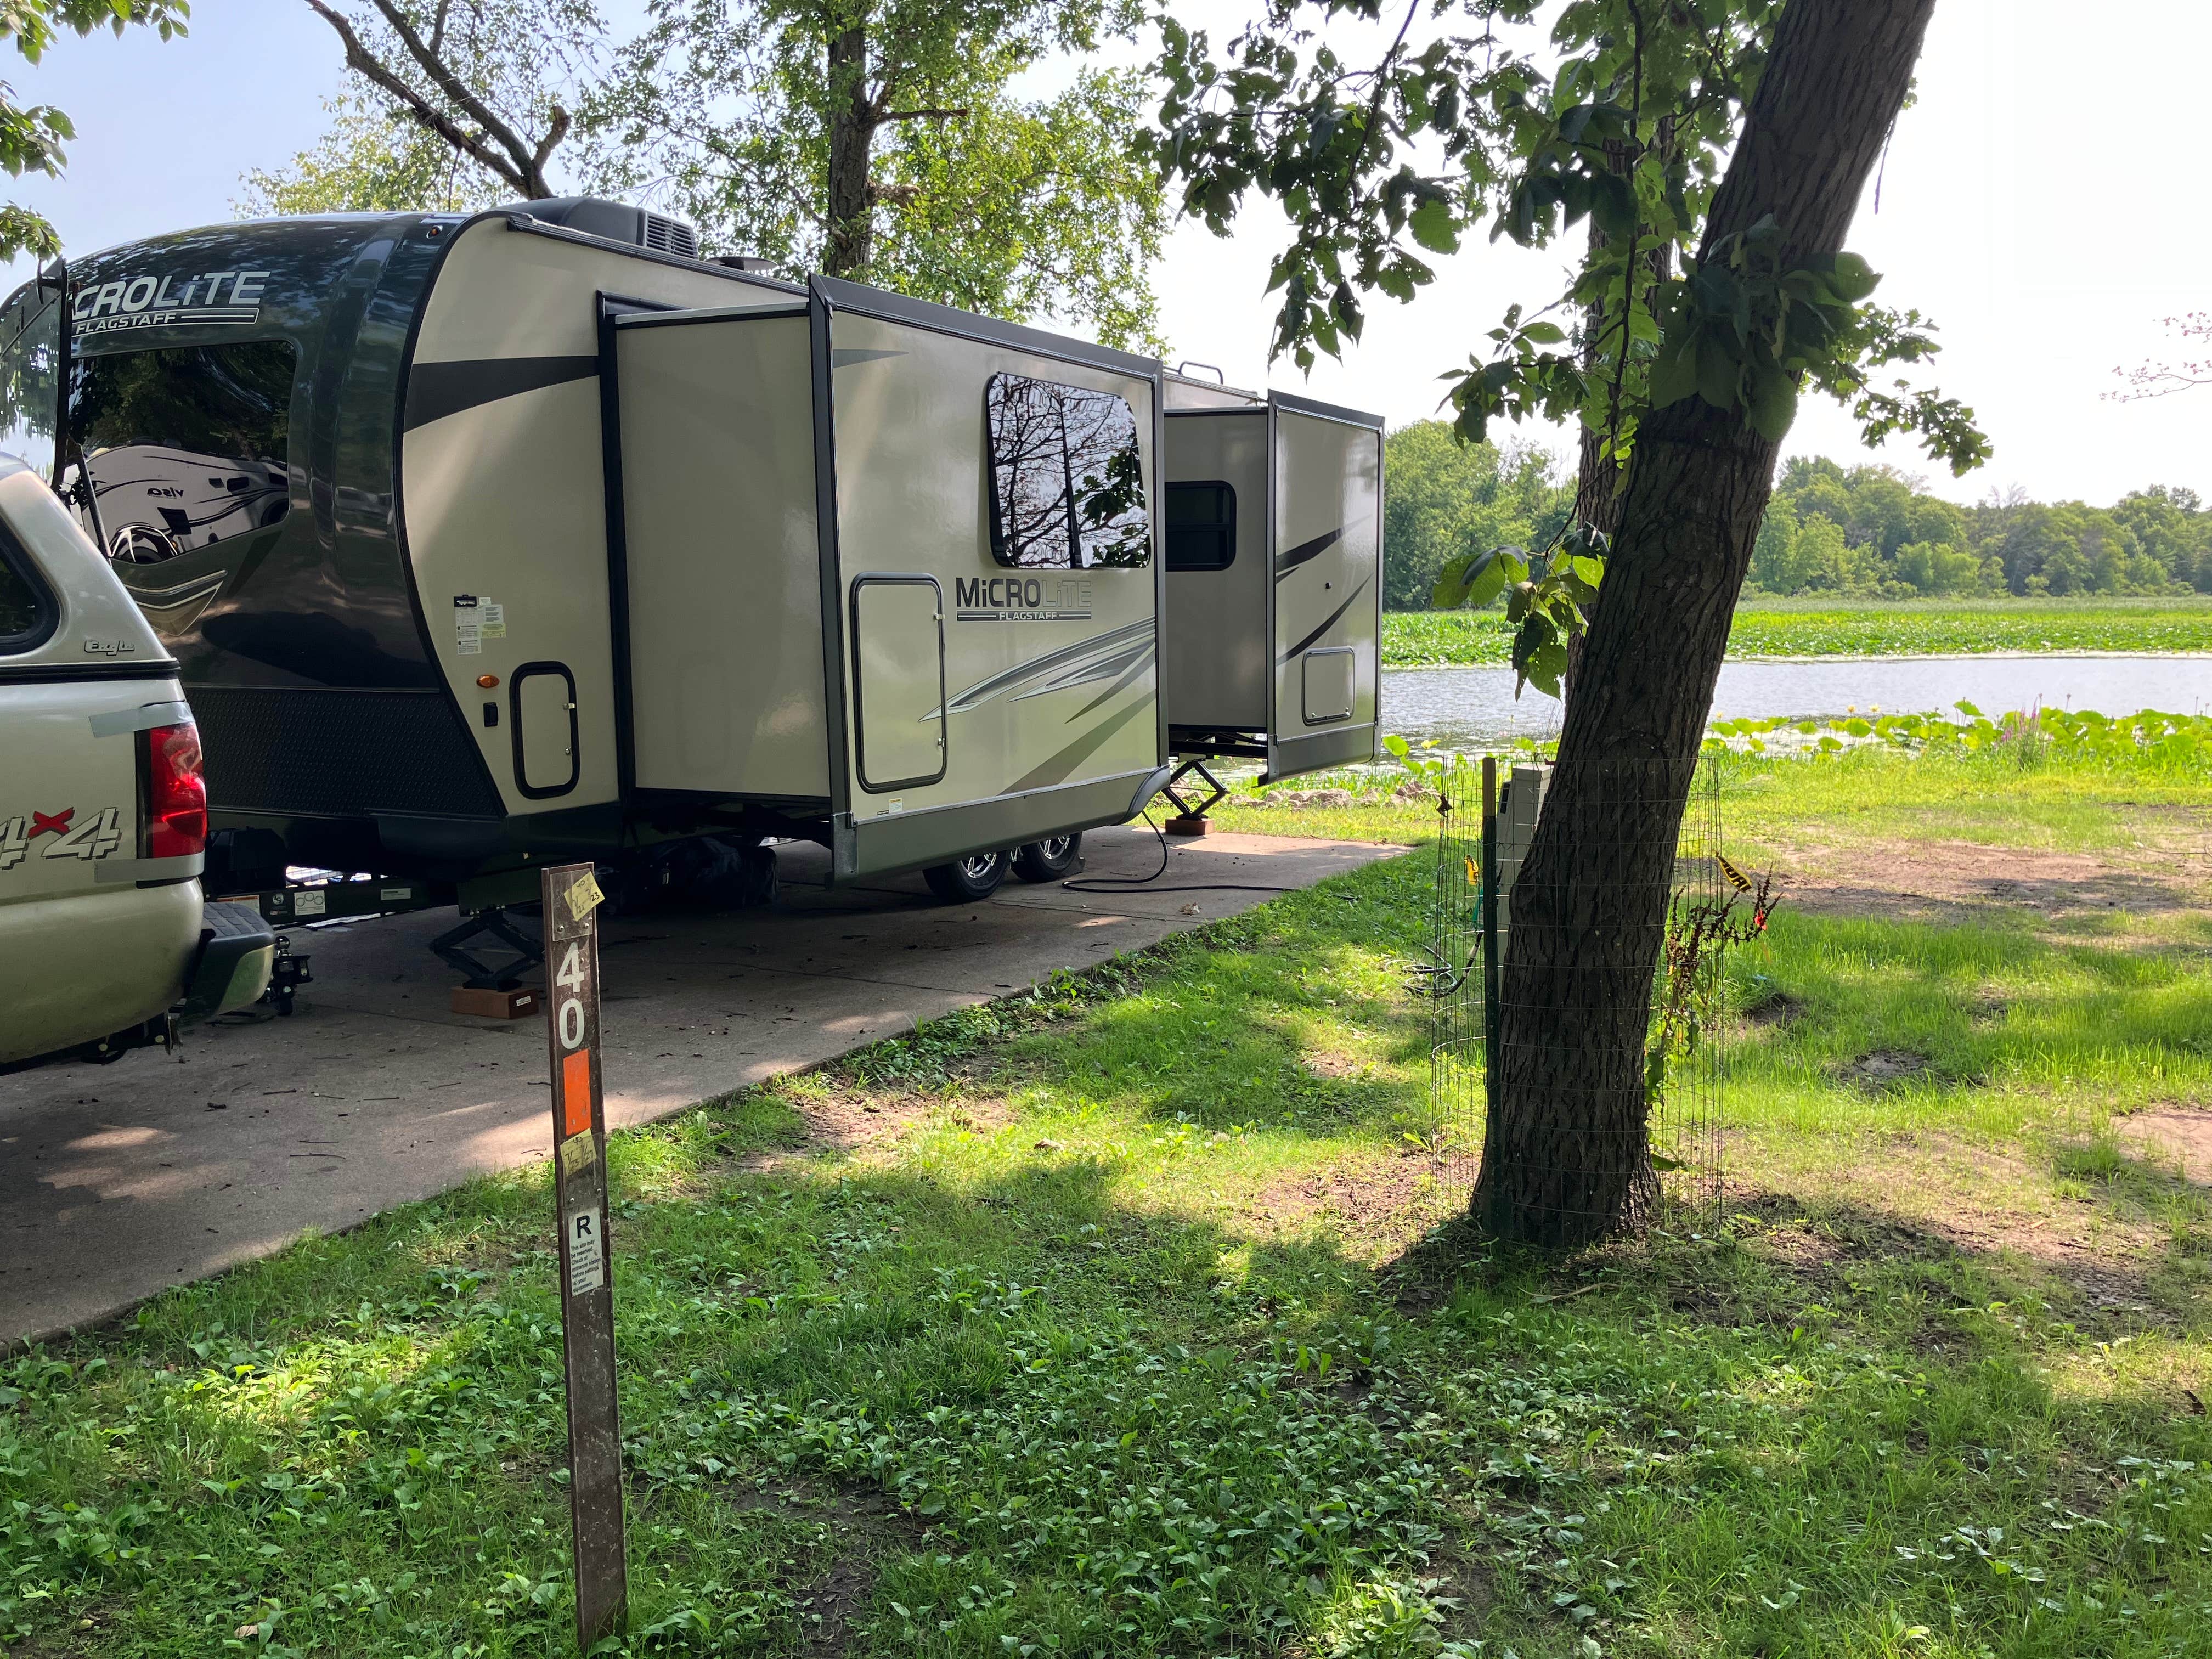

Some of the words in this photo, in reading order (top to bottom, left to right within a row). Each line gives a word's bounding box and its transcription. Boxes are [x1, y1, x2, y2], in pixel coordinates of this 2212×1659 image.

[76, 312, 177, 334] FLAGSTAFF
[999, 612, 1057, 620] FLAGSTAFF
[556, 941, 585, 1049] 40
[577, 1215, 592, 1239] R
